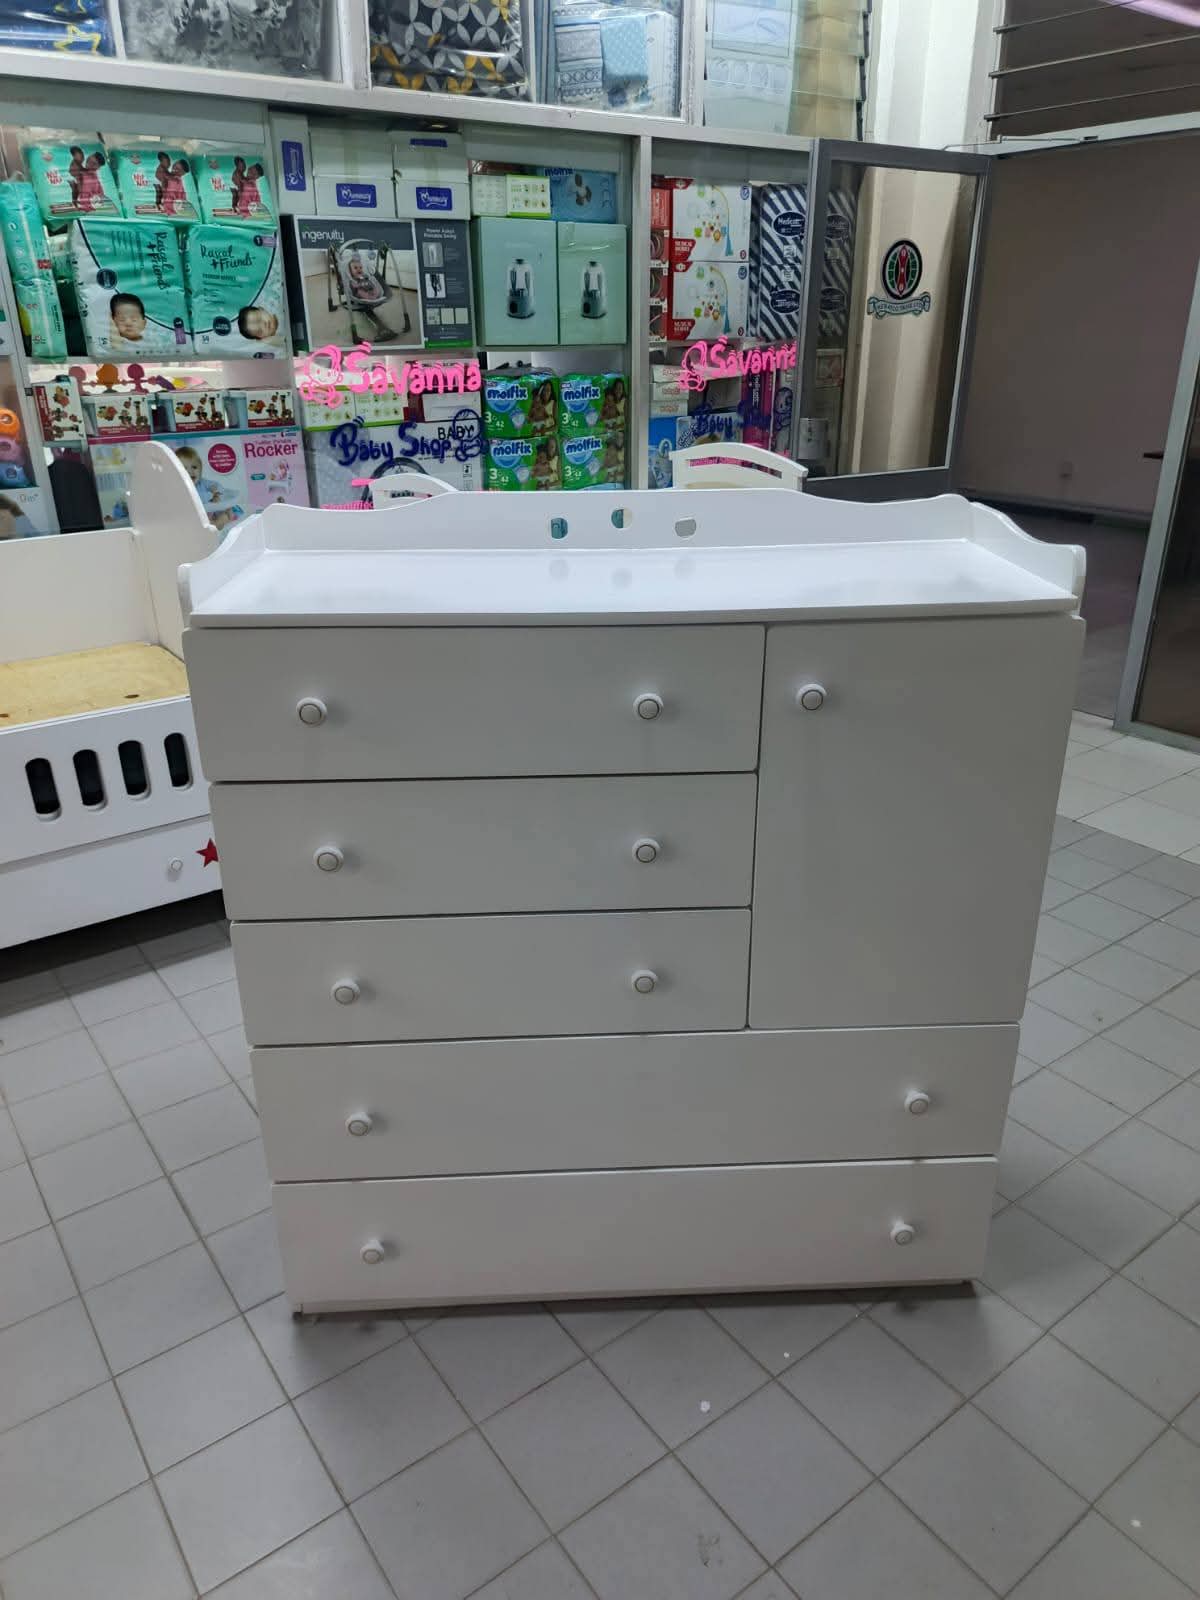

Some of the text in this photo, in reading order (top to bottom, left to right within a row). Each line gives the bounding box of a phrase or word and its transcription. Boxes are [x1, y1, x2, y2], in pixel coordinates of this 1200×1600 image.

[301, 229, 345, 243] ingenuity
[200, 243, 234, 259] Rascal
[710, 335, 796, 378] Savanna
[344, 342, 481, 395] Savanna
[487, 386, 528, 401] molfix
[563, 386, 600, 401] molfix
[484, 411, 493, 424] 3
[562, 412, 570, 424] 3
[330, 416, 453, 467] Baby Shop
[492, 440, 532, 456] molfix
[565, 438, 602, 453] molfix
[244, 442, 298, 459] Rocker
[489, 468, 498, 480] 3
[564, 465, 572, 477] 3
